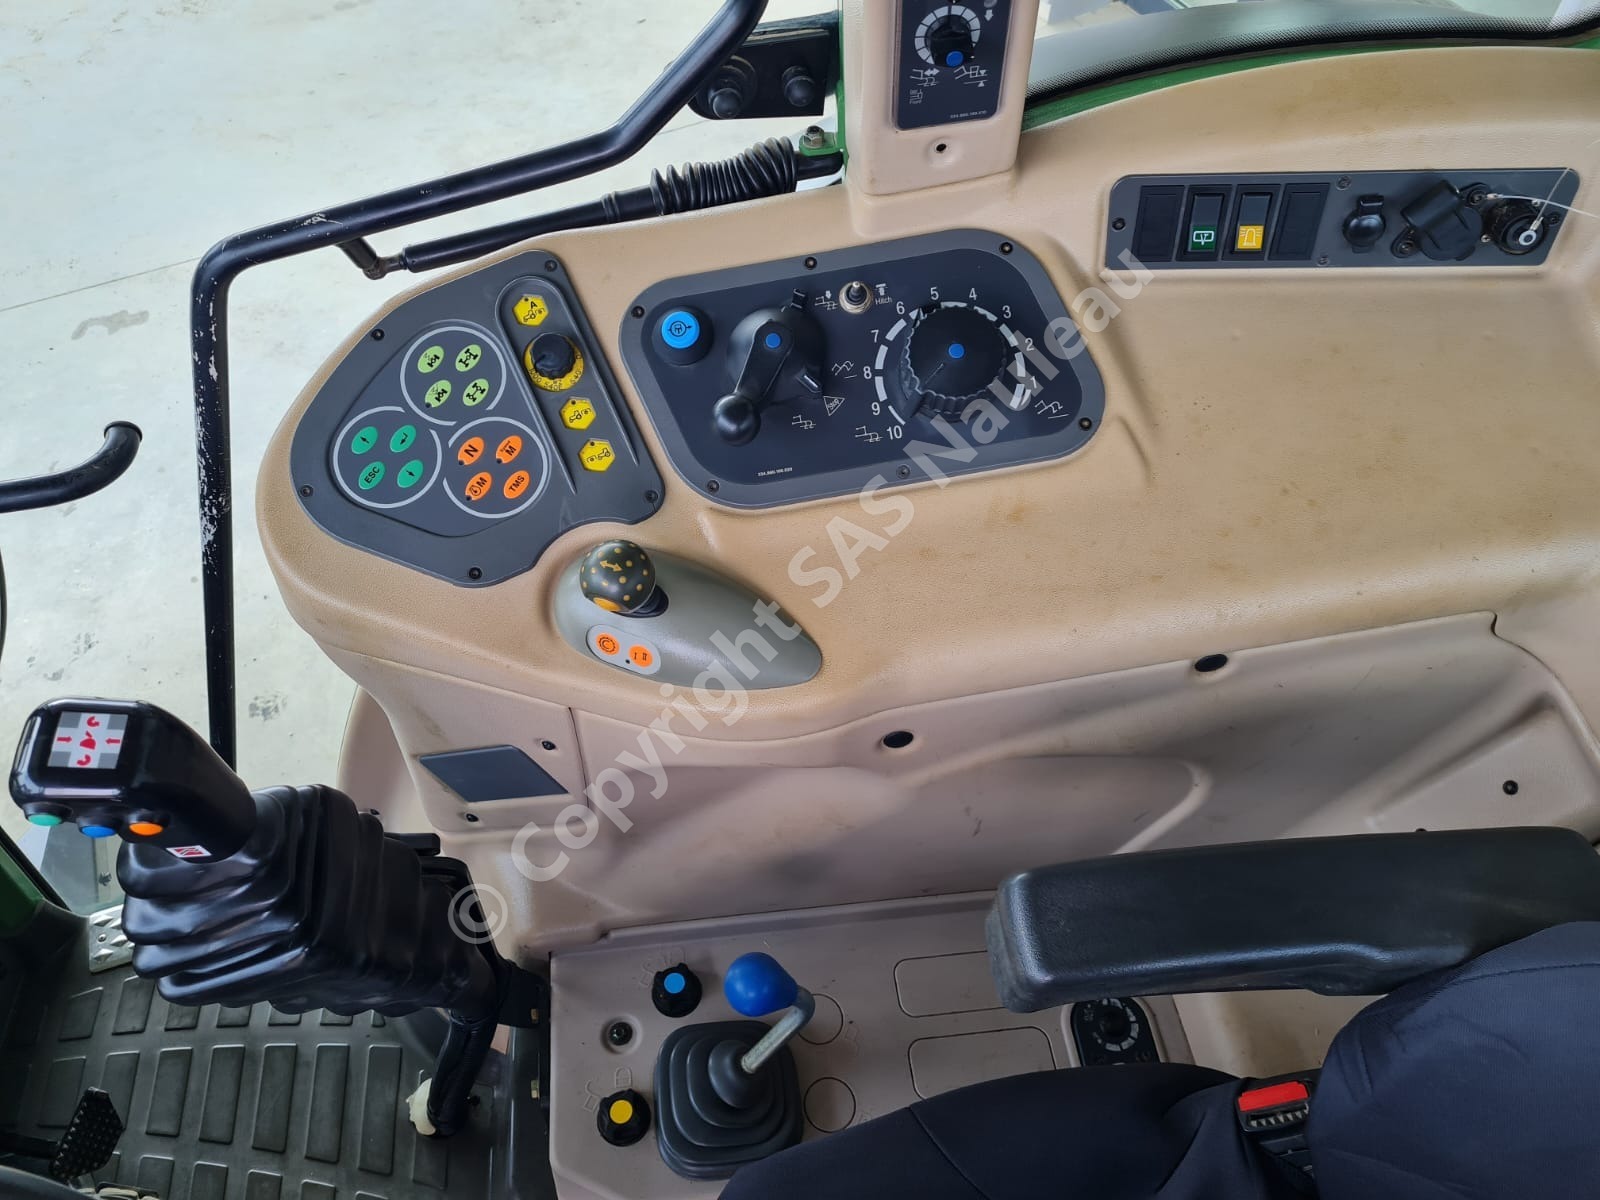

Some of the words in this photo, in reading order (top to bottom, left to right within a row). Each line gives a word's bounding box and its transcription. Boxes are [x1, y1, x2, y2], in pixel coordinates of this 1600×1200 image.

[930, 286, 939, 300] 5
[969, 288, 977, 301] 4
[530, 301, 538, 310] A
[896, 301, 905, 315] 6
[1002, 305, 1012, 319] 3
[871, 330, 881, 343] 7
[1025, 337, 1035, 351] 2
[863, 366, 872, 379] 8
[1030, 375, 1038, 389] 1
[871, 402, 881, 415] 9
[886, 425, 903, 440] 10
[463, 443, 479, 458] N
[504, 444, 518, 457] M
[363, 466, 380, 484] ESC
[475, 476, 489, 488] M
[508, 474, 526, 492] TMS
